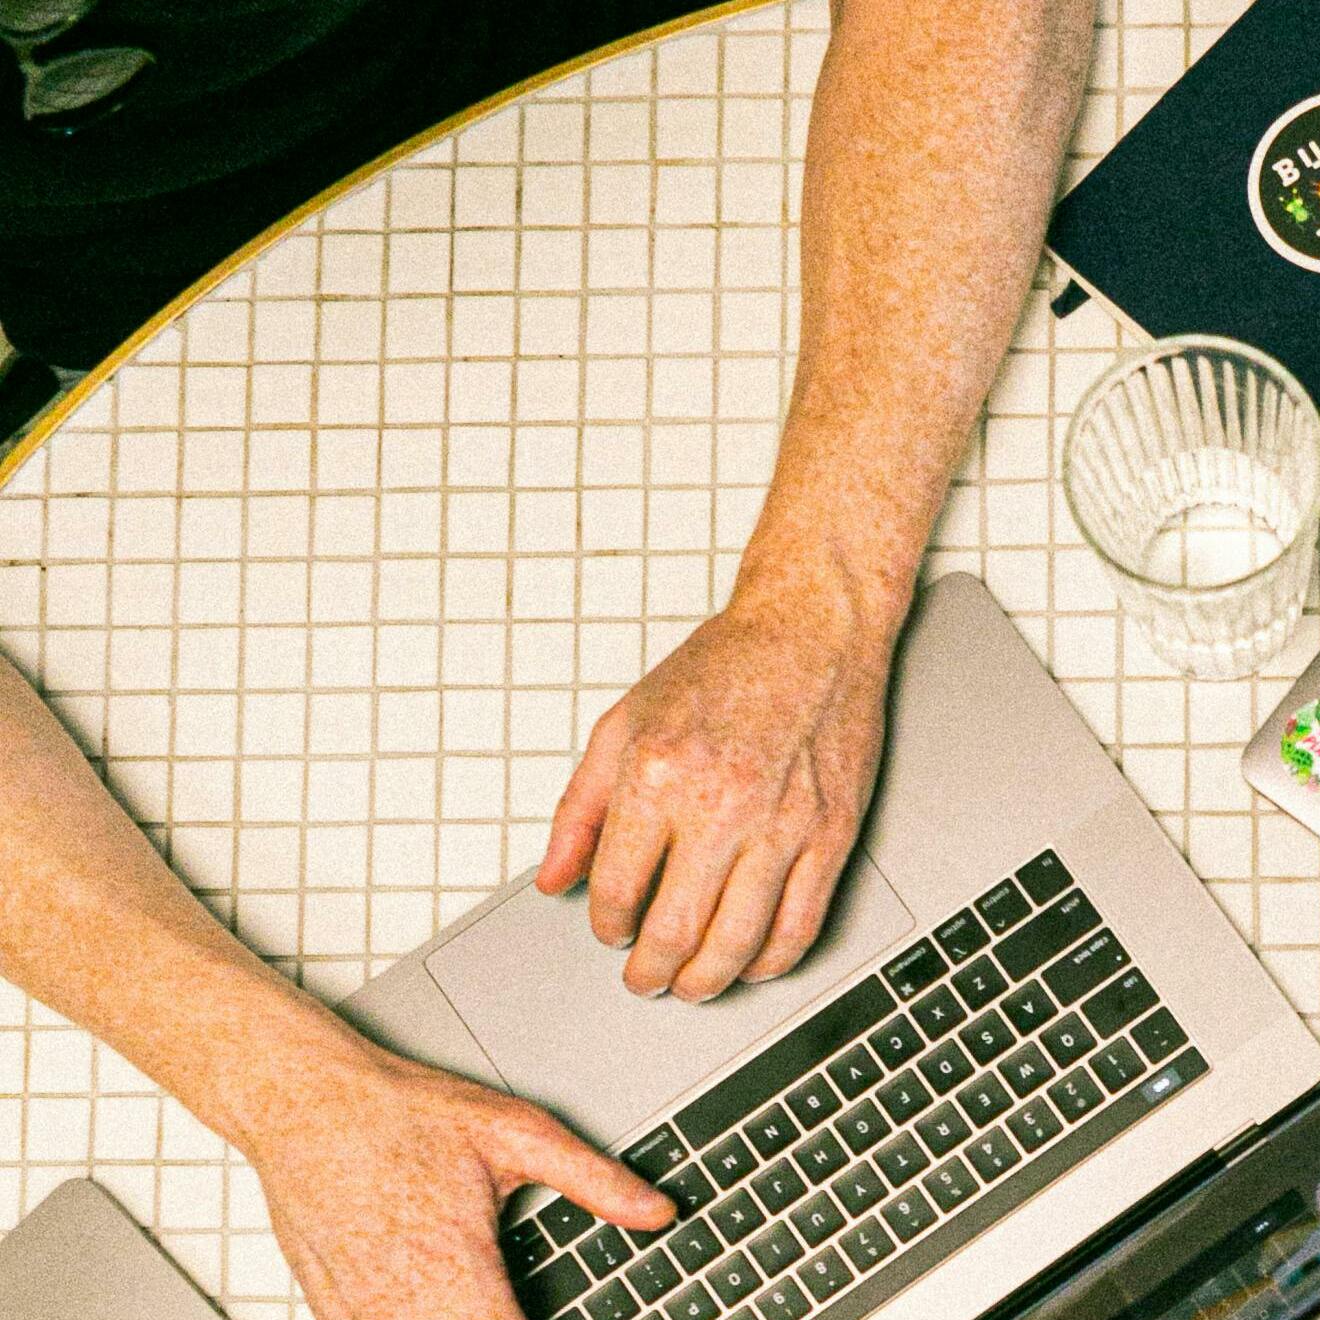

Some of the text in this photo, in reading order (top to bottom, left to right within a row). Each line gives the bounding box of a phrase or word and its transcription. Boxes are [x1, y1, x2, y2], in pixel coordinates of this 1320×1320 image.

[972, 976, 986, 991] Z
[931, 1006, 945, 1021] X
[1021, 1001, 1035, 1014] A
[889, 1036, 903, 1050] C
[981, 1031, 995, 1045] S
[1060, 1033, 1075, 1048] Q
[1107, 1054, 1119, 1066] 1
[849, 1067, 863, 1080] V
[939, 1060, 954, 1075] D
[1019, 1063, 1035, 1079] W
[1065, 1081, 1078, 1096] 2
[807, 1095, 821, 1109] B
[900, 1091, 911, 1105] F
[978, 1093, 992, 1107] E
[1023, 1111, 1036, 1126] 3
[764, 1125, 779, 1140] N
[855, 1120, 870, 1135] G
[936, 1123, 951, 1137] R
[981, 1142, 993, 1155] 4
[722, 1154, 738, 1170] M
[813, 1150, 829, 1164] H
[896, 1154, 909, 1167] T
[939, 1171, 953, 1185] 5
[773, 1180, 783, 1194] J
[855, 1184, 867, 1197] Y
[897, 1201, 911, 1215] 6
[730, 1209, 745, 1224] K
[811, 1212, 826, 1227] U
[689, 1239, 703, 1251] L
[859, 1232, 870, 1246] 7
[814, 1261, 828, 1275] 8
[772, 1291, 786, 1305] 9
[688, 1302, 700, 1316] P
